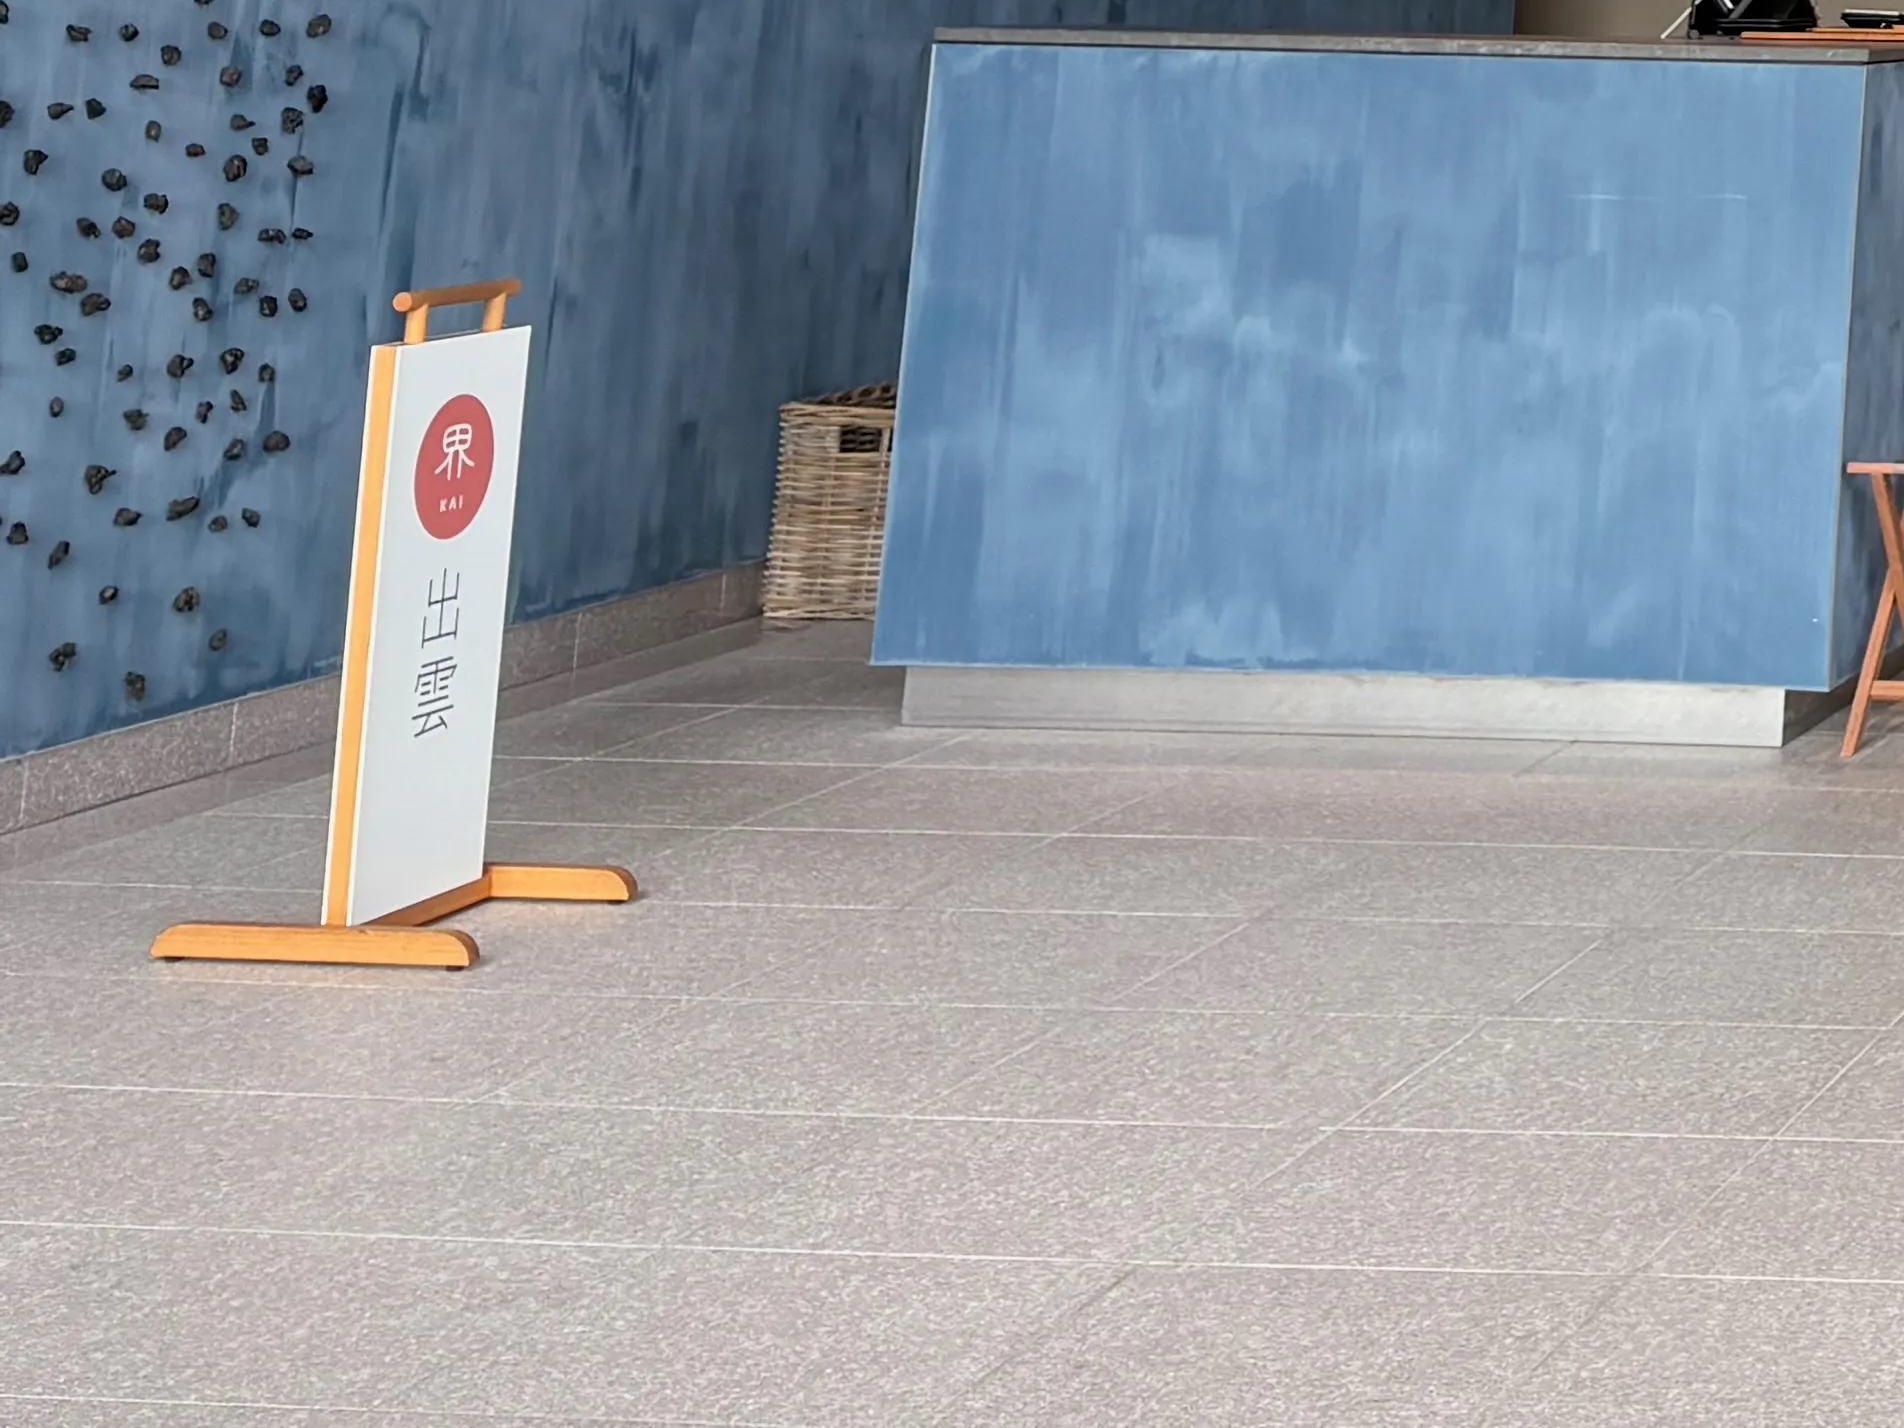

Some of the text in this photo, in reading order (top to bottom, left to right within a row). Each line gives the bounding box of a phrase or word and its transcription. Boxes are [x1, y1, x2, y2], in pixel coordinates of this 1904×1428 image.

[435, 423, 475, 481] 界
[439, 495, 464, 513] KAI
[411, 567, 460, 737] 出雲
